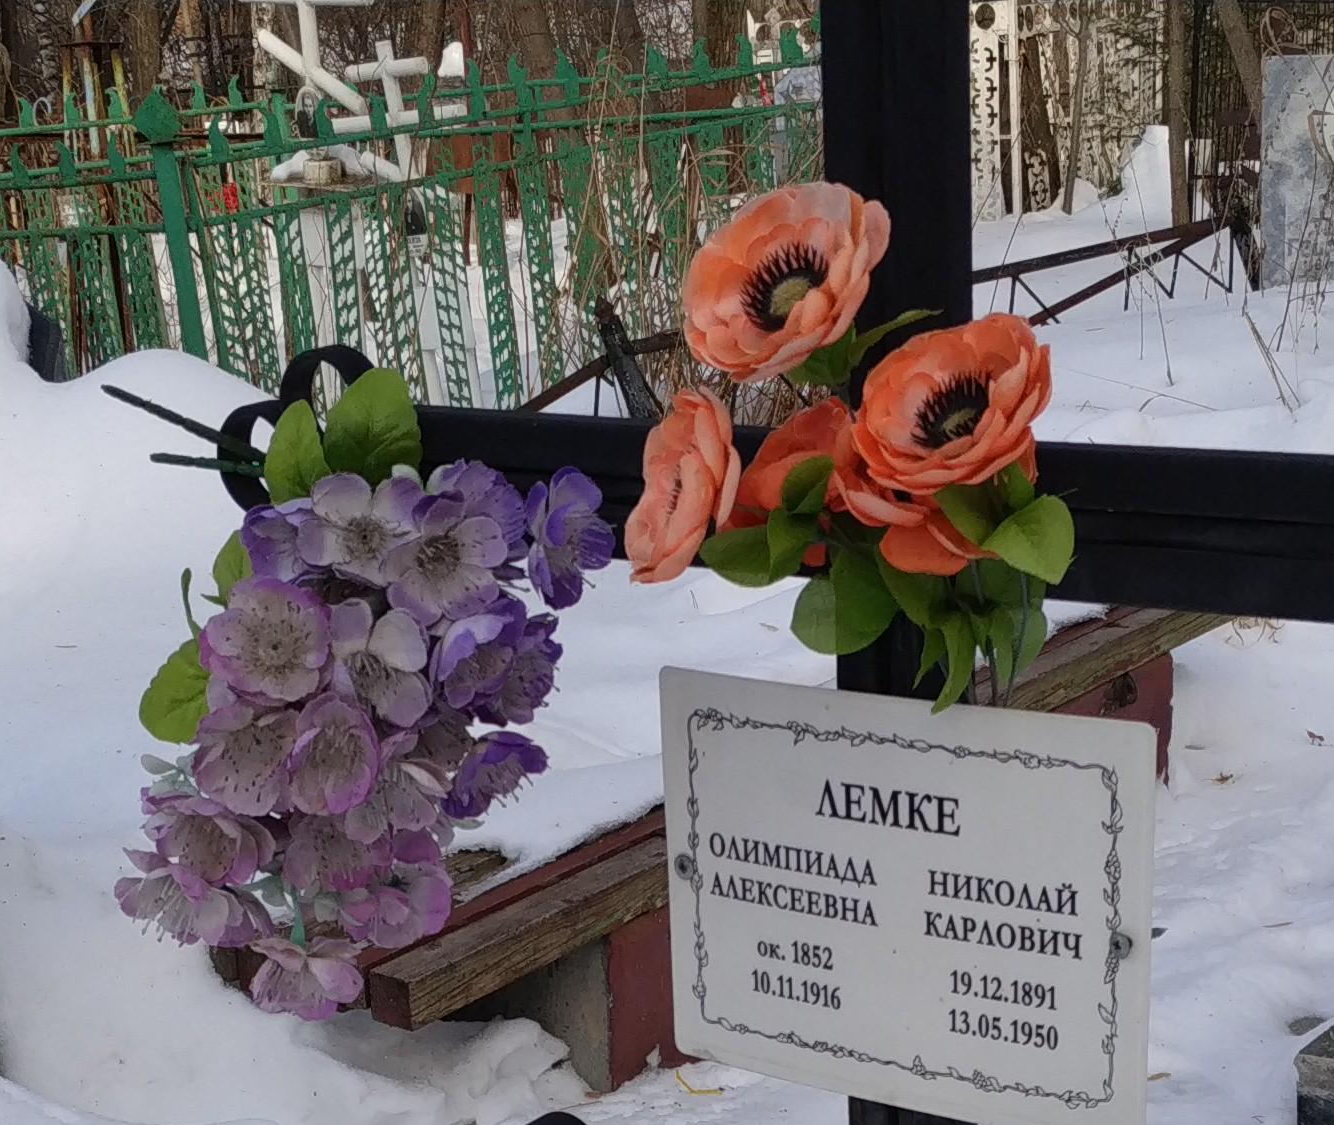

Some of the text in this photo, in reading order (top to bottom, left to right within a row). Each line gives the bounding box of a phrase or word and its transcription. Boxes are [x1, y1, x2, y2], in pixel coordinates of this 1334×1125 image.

[814, 779, 961, 837] ЛЕМКЕ
[708, 832, 878, 887] ОЛИМПИАДА
[709, 872, 879, 928] АЛЕКСЕЕВНА
[927, 869, 1079, 917] НИКОЛАЙ
[756, 939, 834, 970] ок. 1852
[923, 910, 1083, 960] КАРЛОВИЧ
[750, 969, 842, 1011] 10.11.1916
[948, 970, 1058, 1011] 19.12.1891
[947, 1009, 1059, 1051] 13.05.1950
